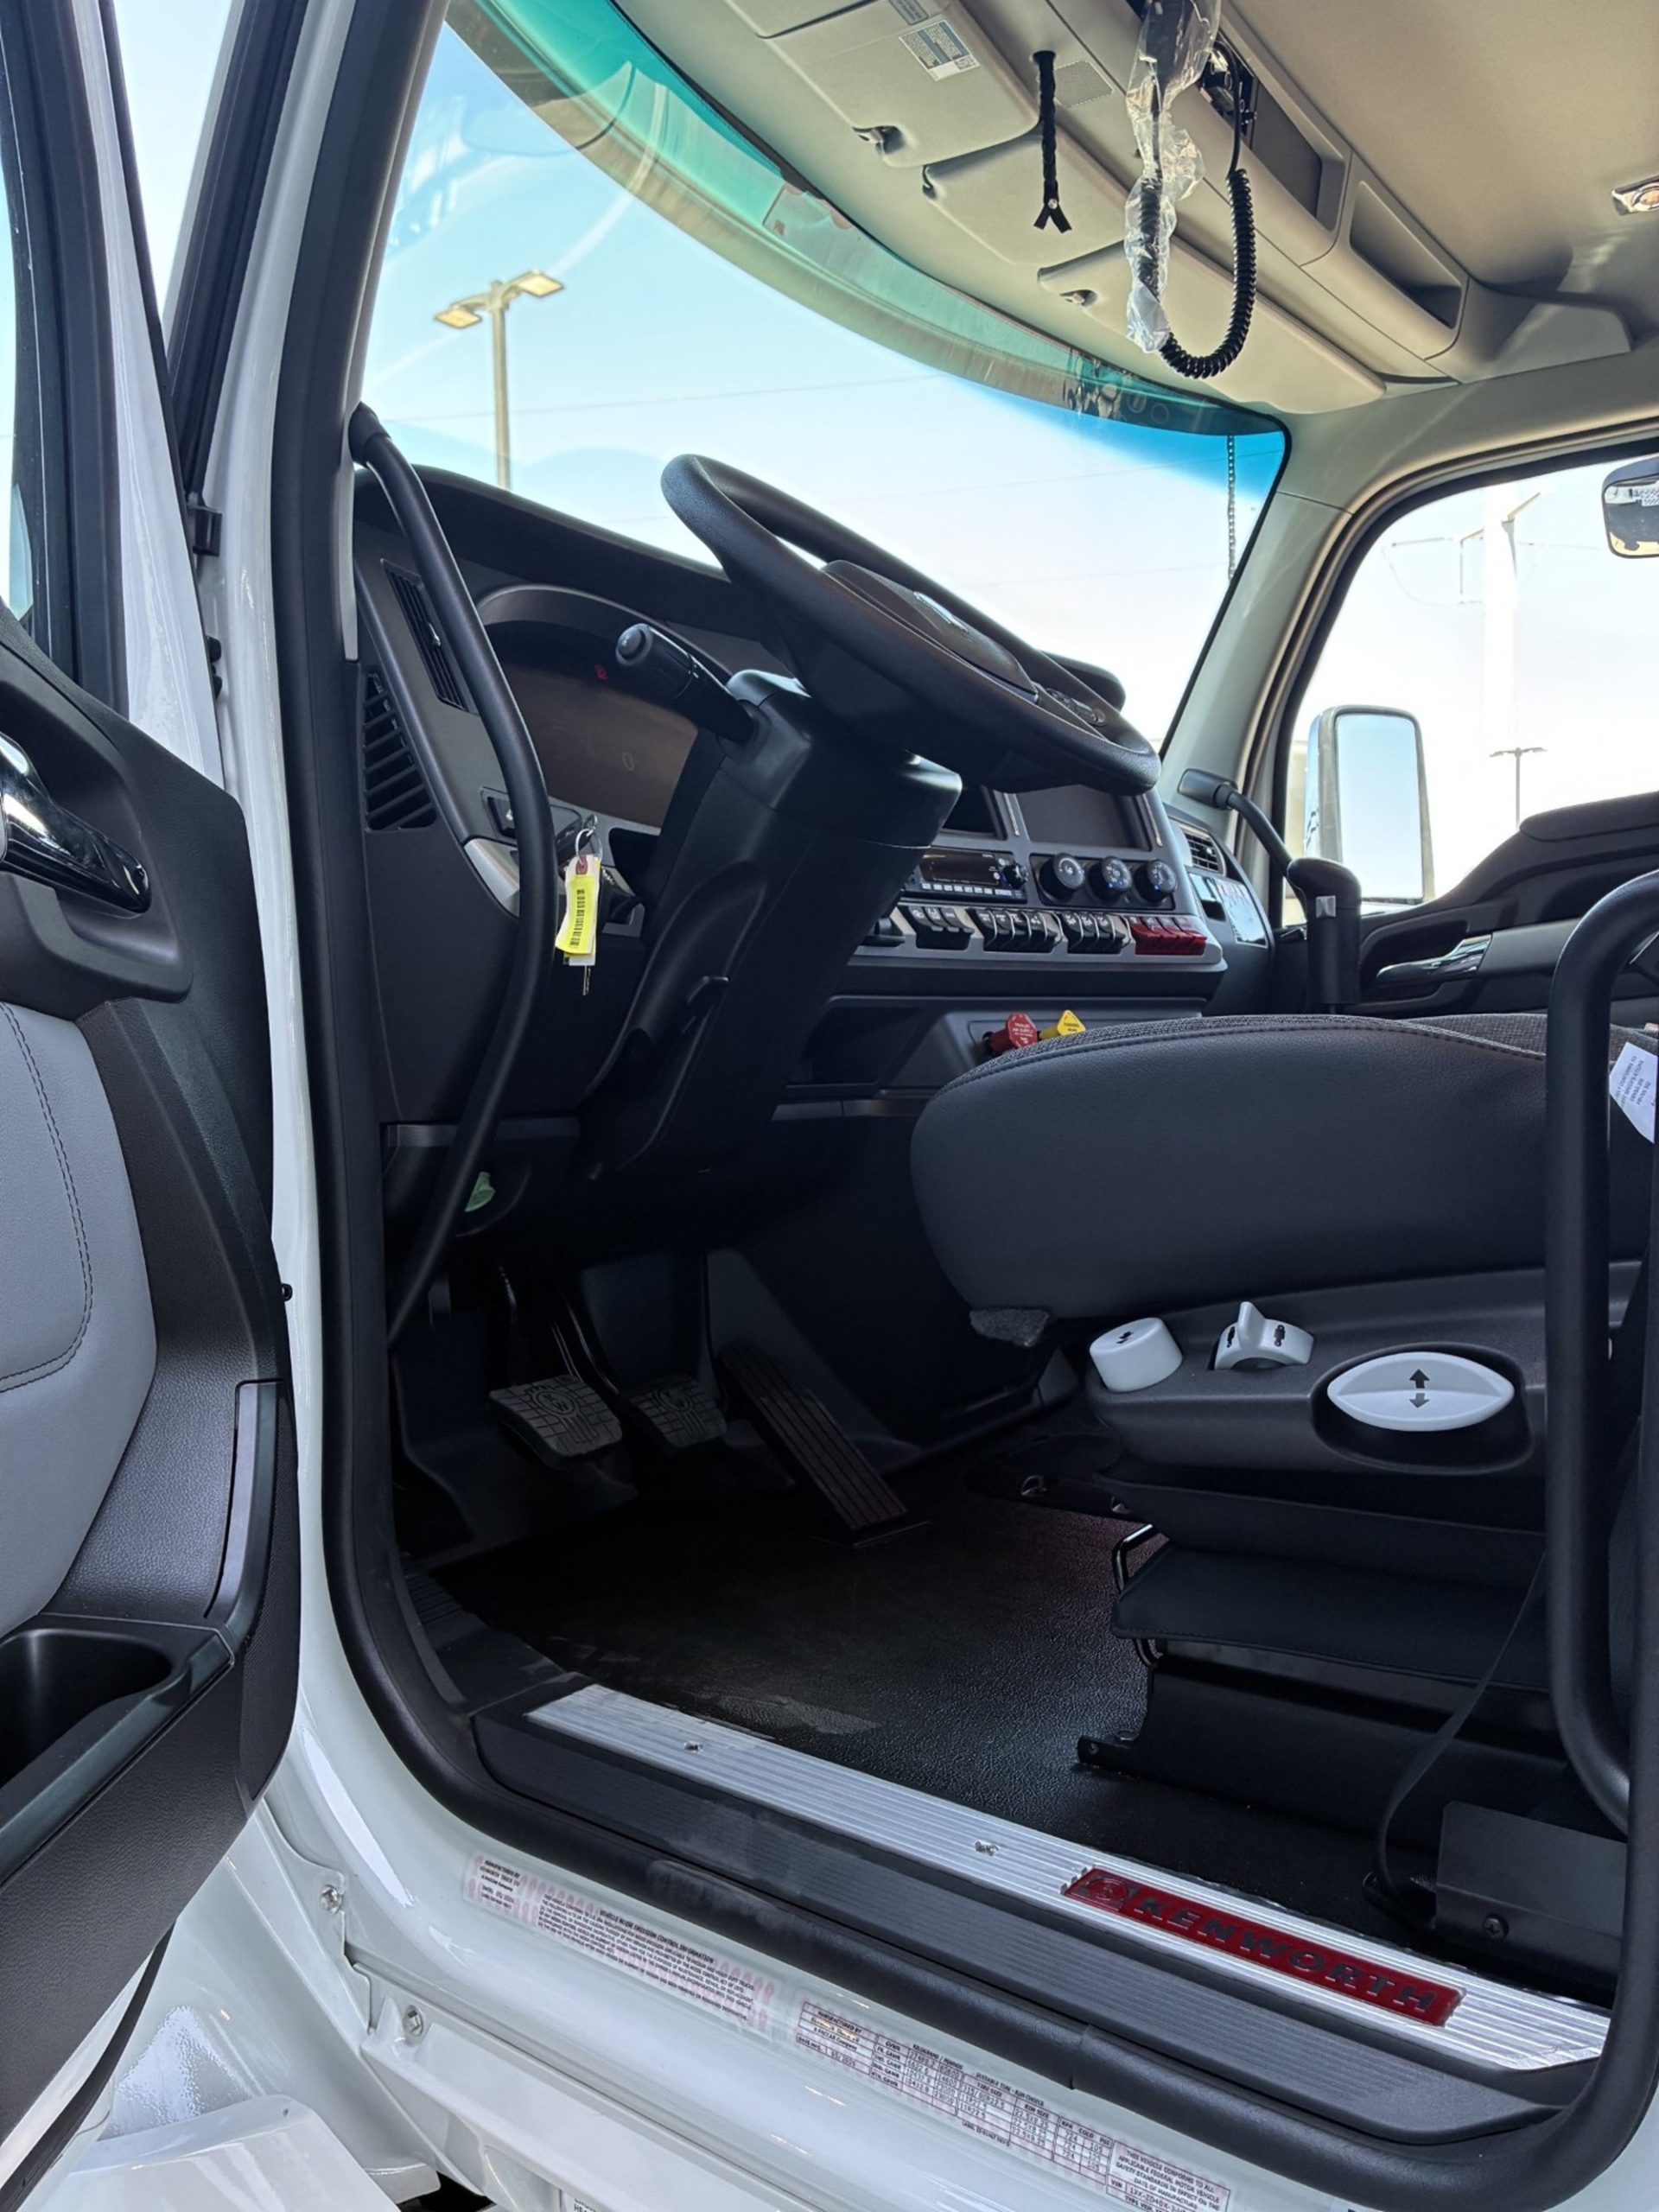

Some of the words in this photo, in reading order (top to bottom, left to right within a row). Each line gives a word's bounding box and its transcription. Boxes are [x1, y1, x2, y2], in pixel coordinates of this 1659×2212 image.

[657, 1935, 679, 1949] CONTROL
[679, 1943, 714, 1963] INFORMATION
[1134, 1897, 1436, 2012] KENWORTH
[836, 2037, 858, 2050] Company
[1079, 2128, 1094, 2138] COLD
[1111, 2179, 1123, 2189] VIN
[1116, 2162, 1136, 2175] SAFETY
[1198, 2198, 1207, 2206] ON
[1118, 2155, 1149, 2173] APPLICABLE
[1150, 2169, 1174, 2184] FEDERAL
[1175, 2180, 1195, 2192] MOTOR
[1140, 2155, 1163, 2170] VEHICLE
[1164, 2166, 1194, 2184] CONFORMS
[1196, 2179, 1204, 2188] TO
[1204, 2184, 1215, 2193] ALL
